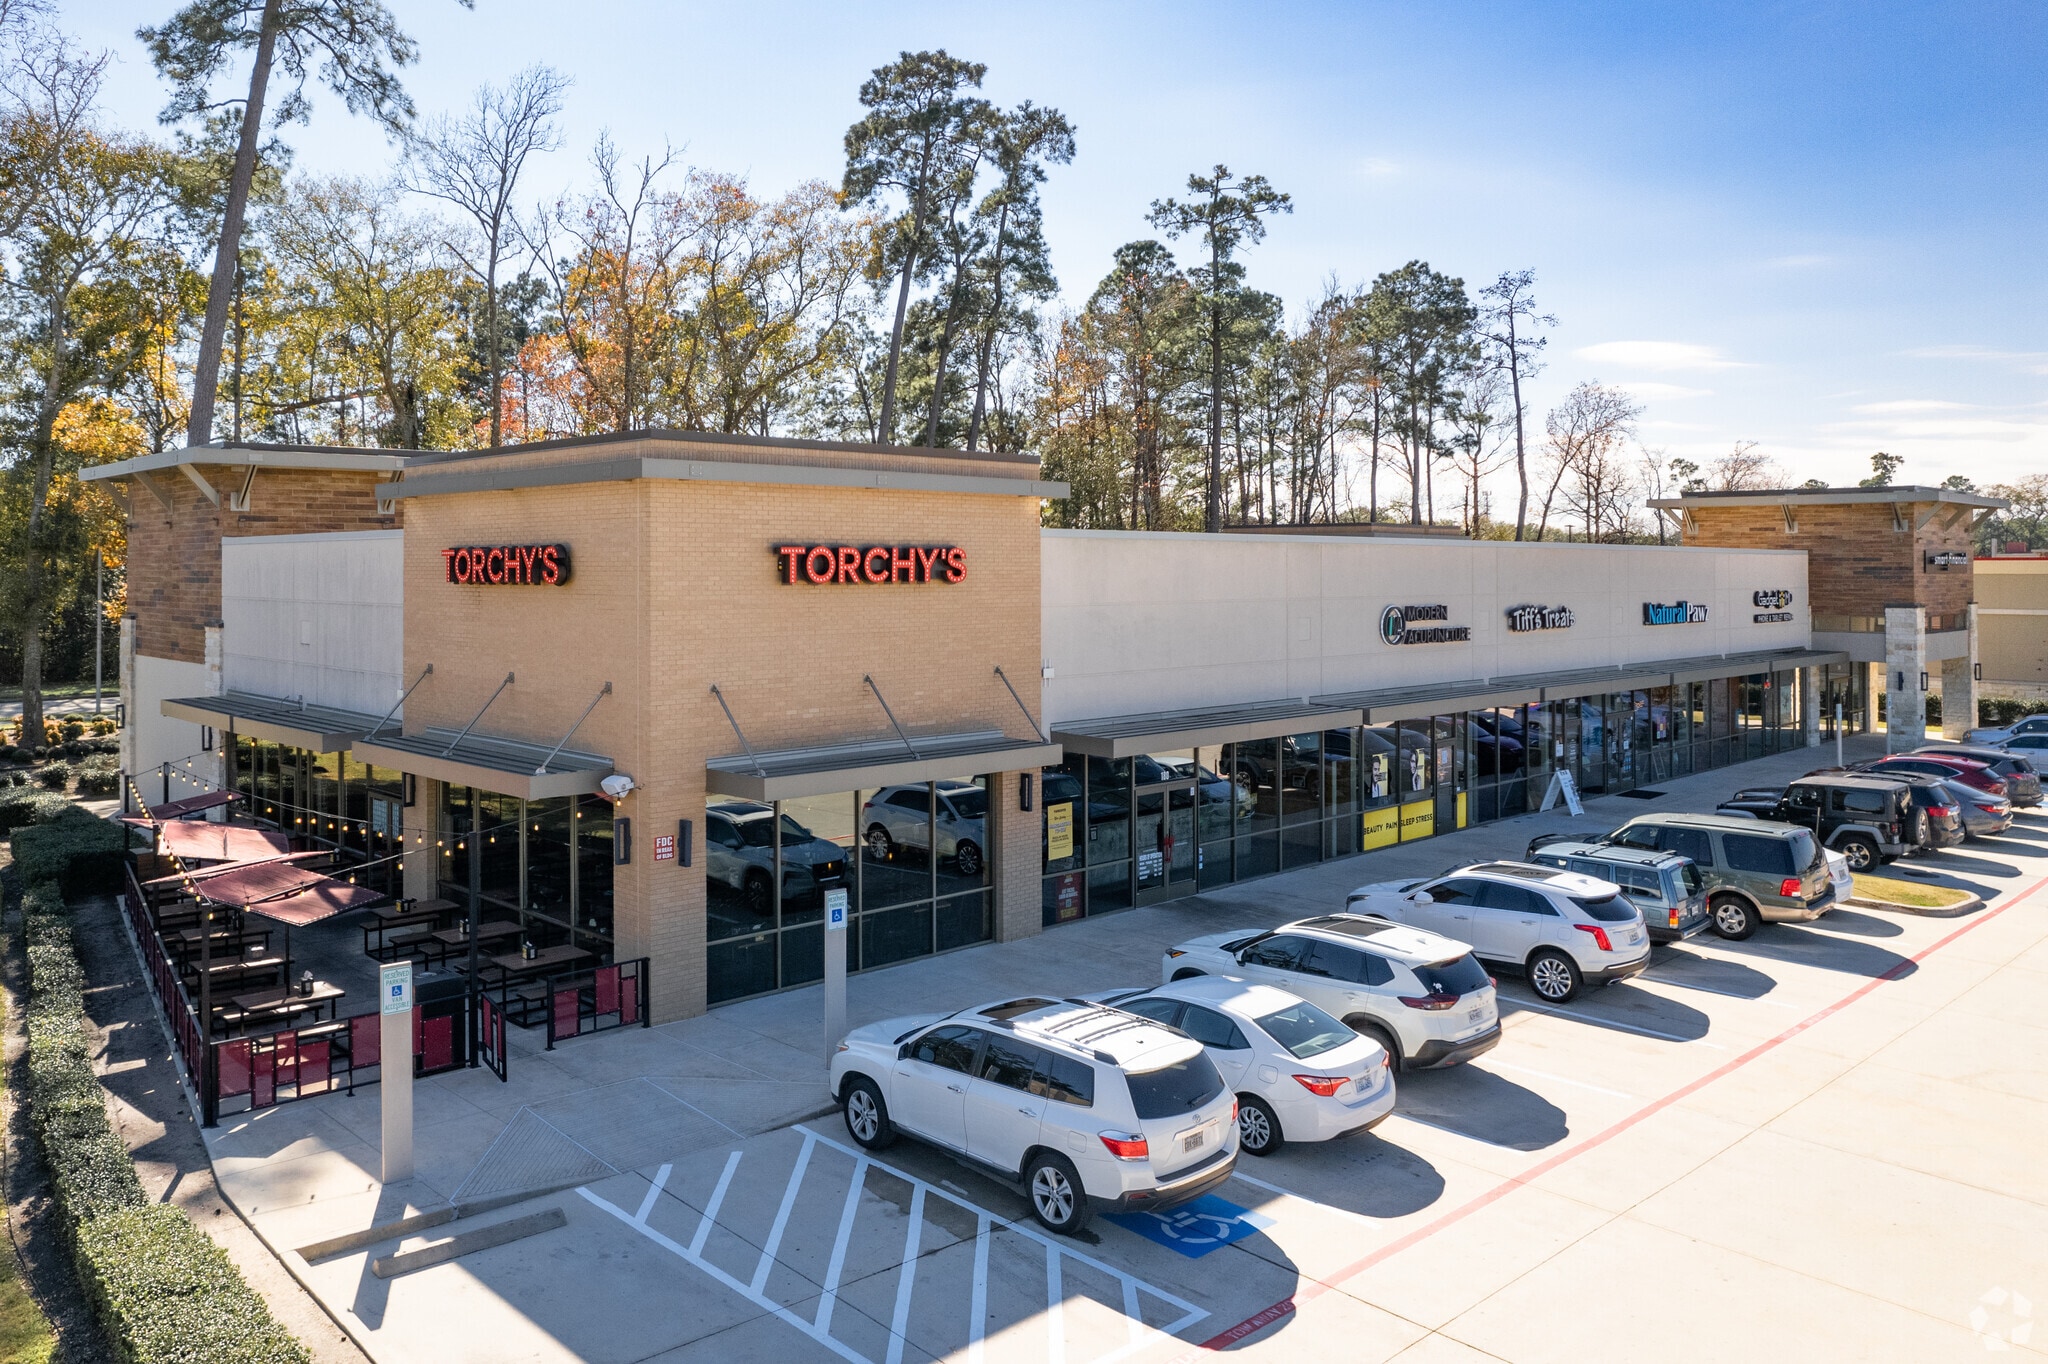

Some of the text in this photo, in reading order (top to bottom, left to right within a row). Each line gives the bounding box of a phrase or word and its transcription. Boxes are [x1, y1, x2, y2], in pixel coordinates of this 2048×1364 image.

[441, 545, 560, 584] TORCHY'S
[780, 546, 967, 584] TORCHY'S
[1407, 605, 1448, 621] MODERN
[1513, 607, 1542, 630] Tiff's
[1542, 607, 1576, 628] Treats
[1407, 627, 1471, 644] ACUPUNCTURE
[1363, 813, 1433, 835] BEAUTY PAIN SLEEP STRESS
[656, 836, 673, 847] FDC
[384, 970, 409, 978] RESERVED
[385, 978, 408, 986] PARKING
[385, 1001, 409, 1010] ACCESSIBLE
[1224, 1322, 1252, 1339] TOW
[1251, 1307, 1282, 1327] AWAY
